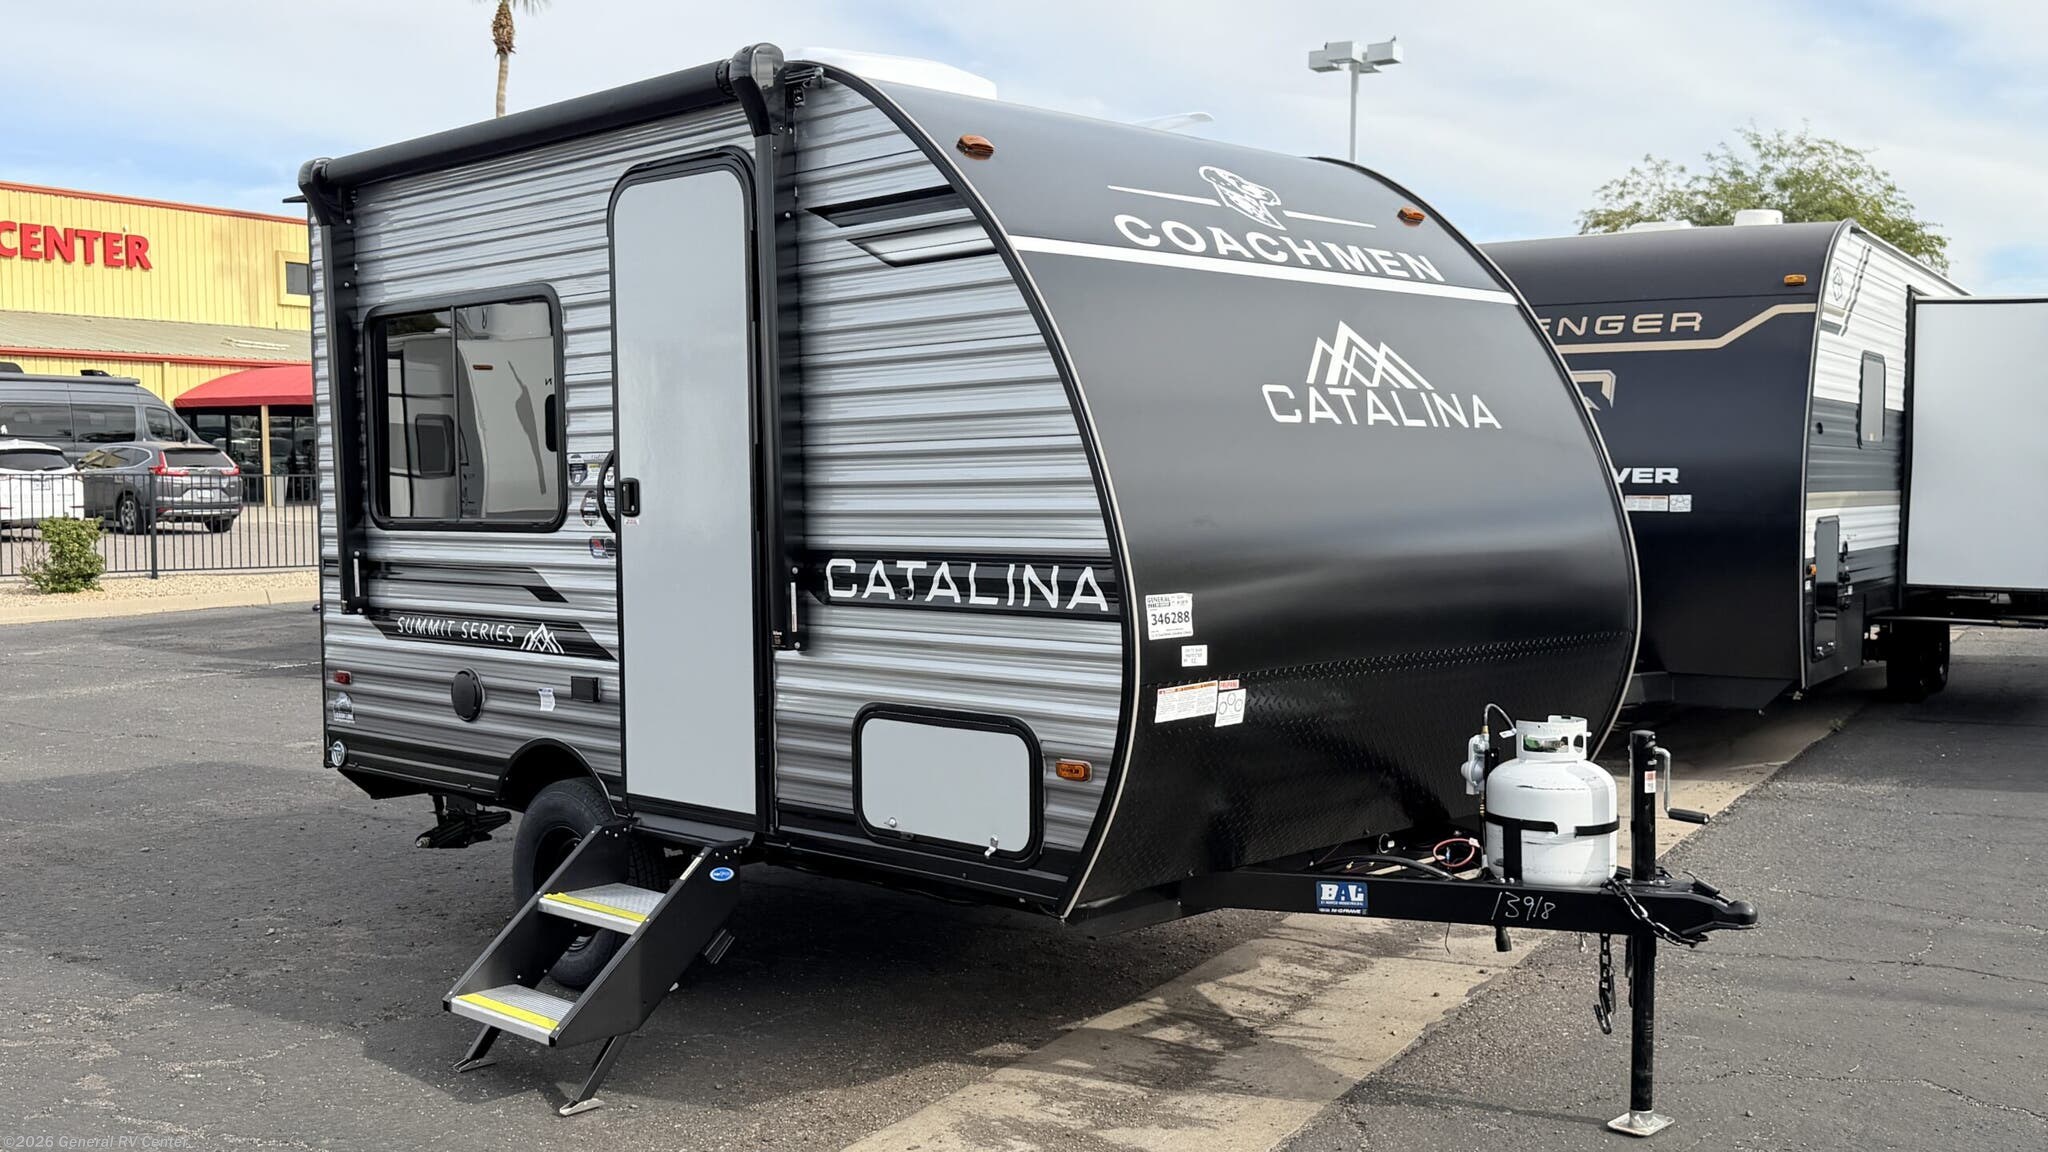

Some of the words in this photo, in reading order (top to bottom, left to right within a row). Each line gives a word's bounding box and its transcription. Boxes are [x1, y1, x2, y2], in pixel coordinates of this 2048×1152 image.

[0, 220, 153, 270] CENTER
[1113, 213, 1446, 283] COACHMEN
[1261, 384, 1503, 430] CATALINA
[825, 557, 1109, 612] CATALINA
[397, 616, 455, 637] SUMMIT
[461, 621, 515, 643] SERIES
[1151, 610, 1191, 626] 346288
[1320, 883, 1365, 902] BAL
[1490, 891, 1557, 921] 13918
